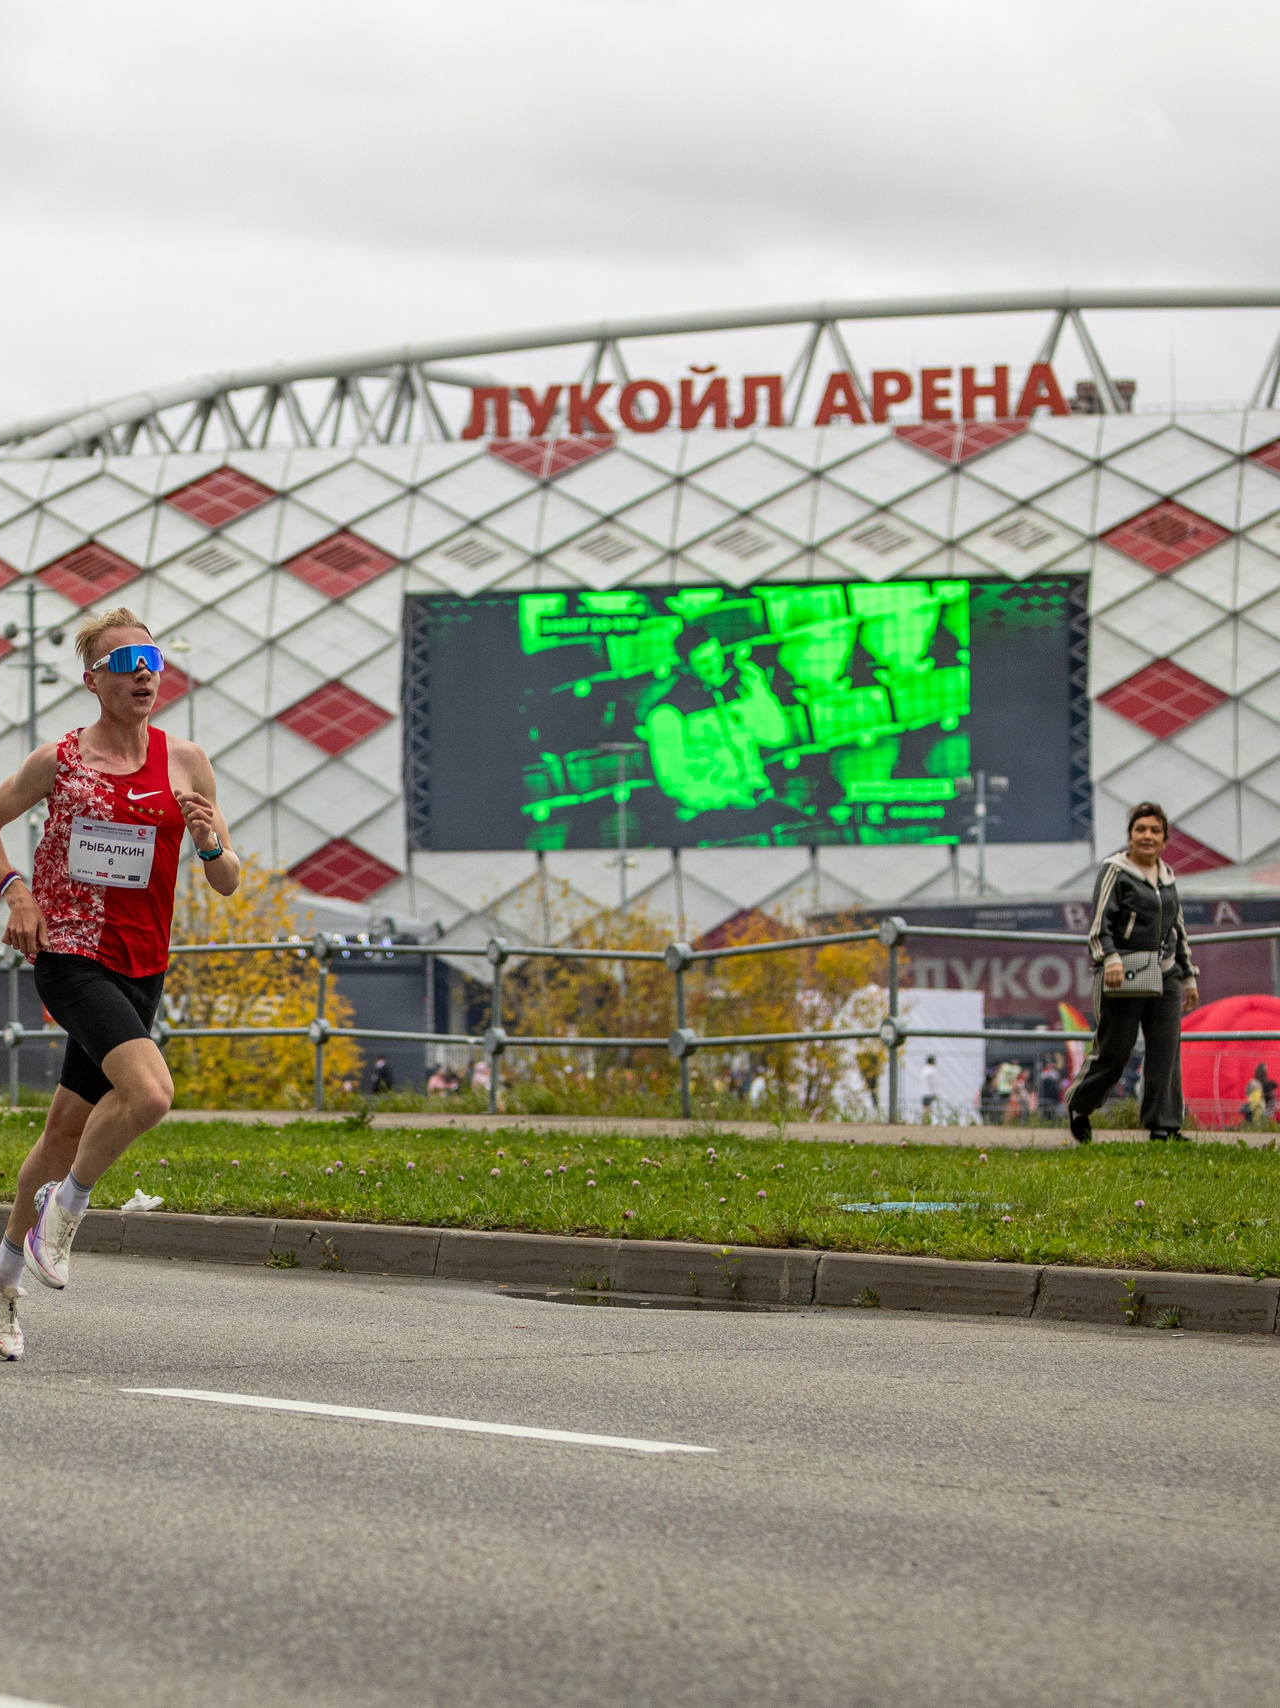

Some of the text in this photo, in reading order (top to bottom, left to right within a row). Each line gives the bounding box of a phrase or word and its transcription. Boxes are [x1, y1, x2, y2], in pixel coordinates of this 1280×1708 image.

[462, 363, 1072, 439] ЛУКОЙЛ АРЕНА
[79, 840, 145, 857] РЫБАЛКИН
